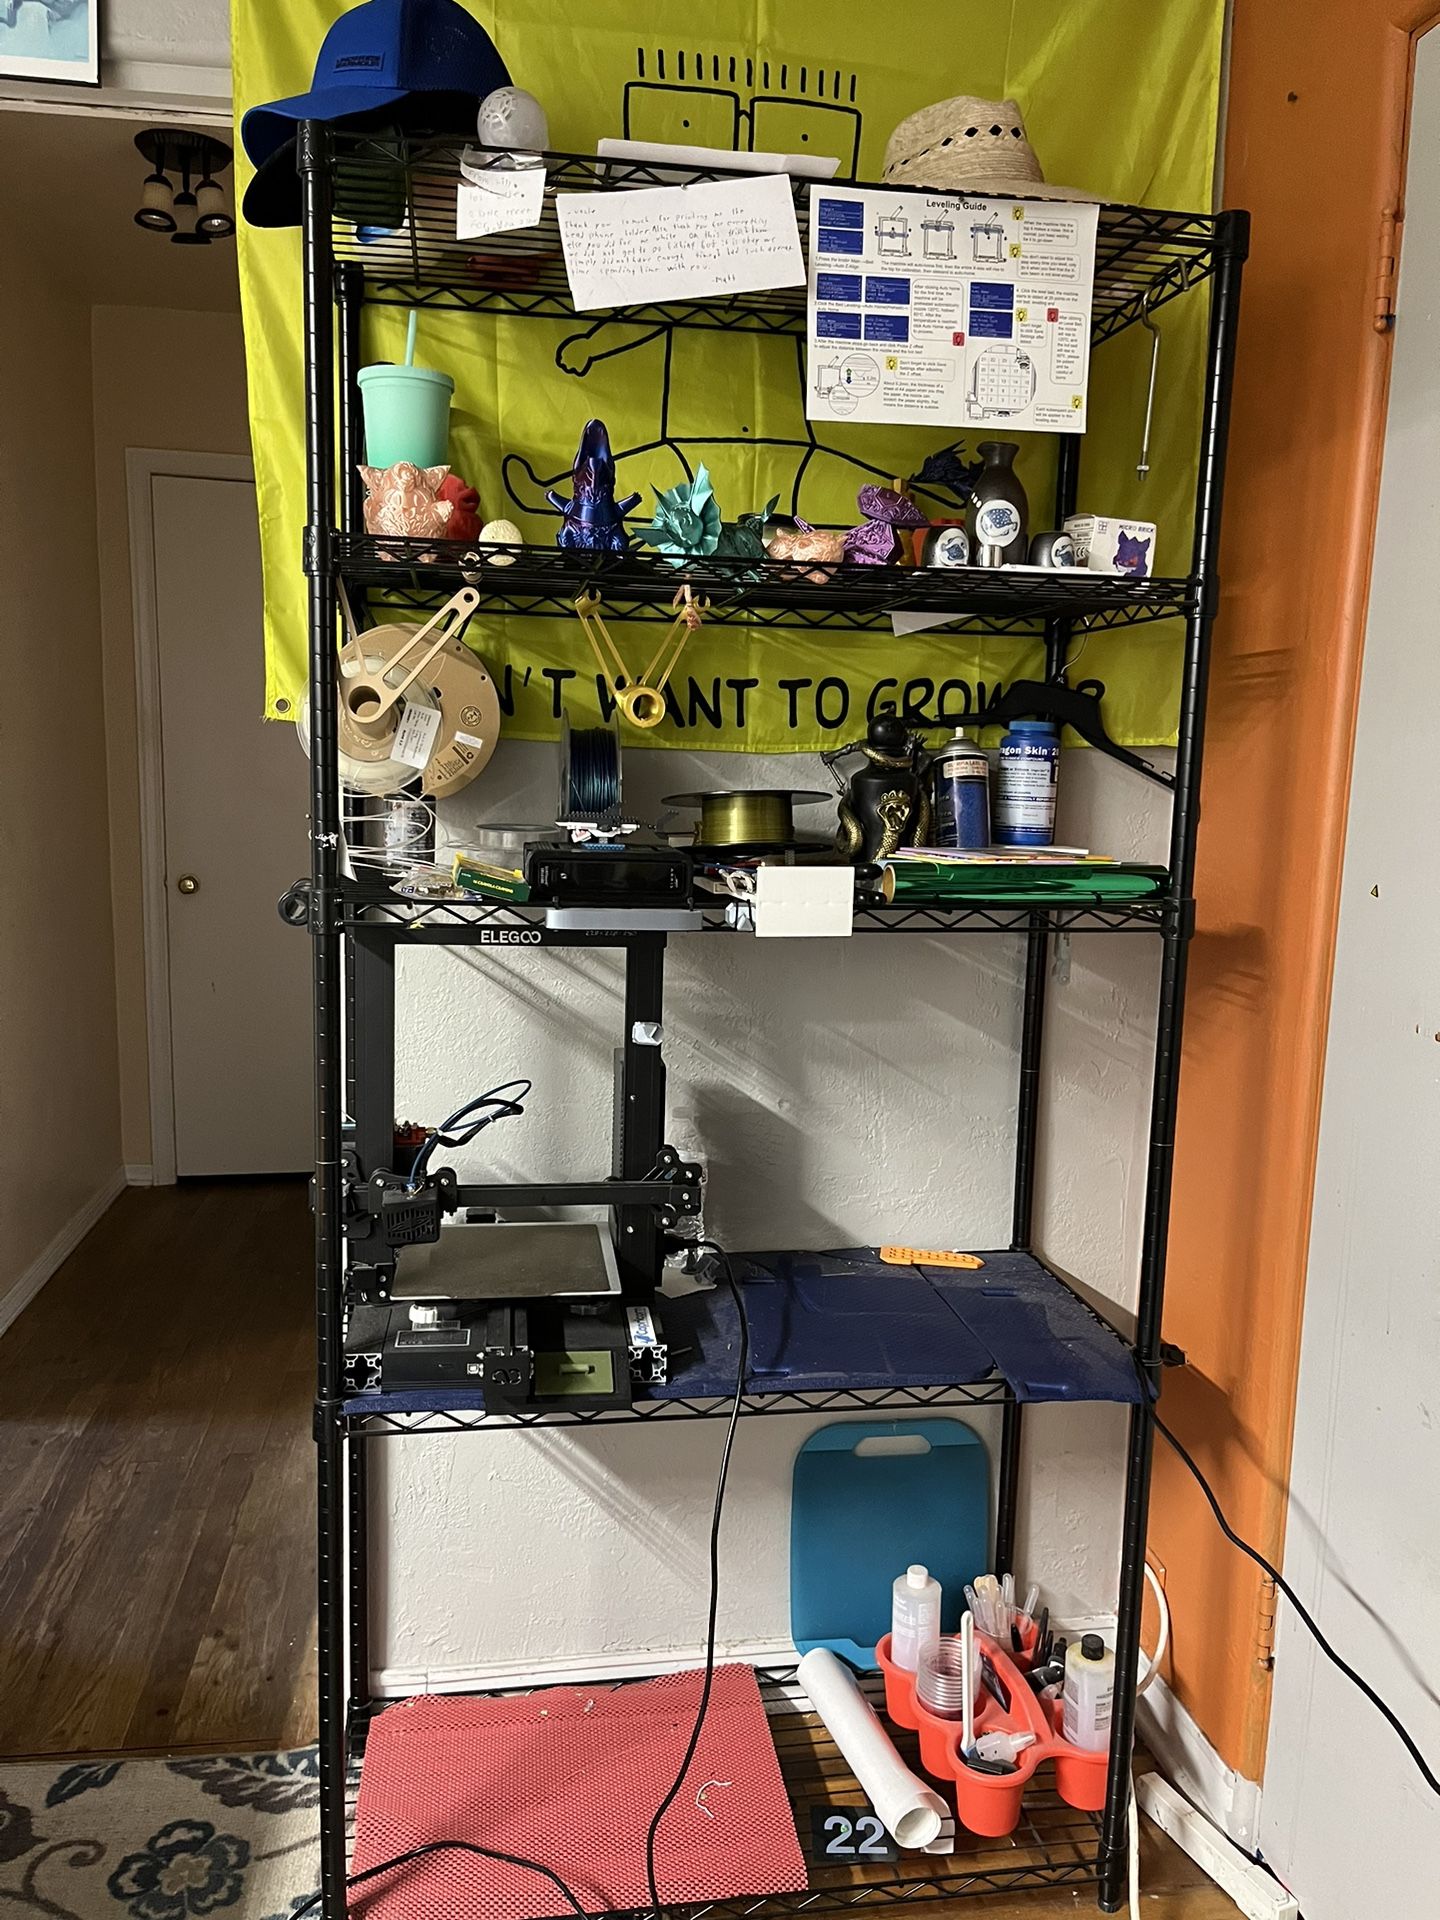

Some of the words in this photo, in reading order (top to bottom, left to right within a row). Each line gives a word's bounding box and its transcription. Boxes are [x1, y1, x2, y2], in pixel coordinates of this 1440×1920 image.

[926, 199, 960, 210] Leveling
[962, 202, 987, 210] Guide
[778, 677, 850, 729] TO
[1025, 746, 1048, 756] Skin
[481, 930, 542, 944] ELEGOO
[824, 1816, 888, 1854] 22
